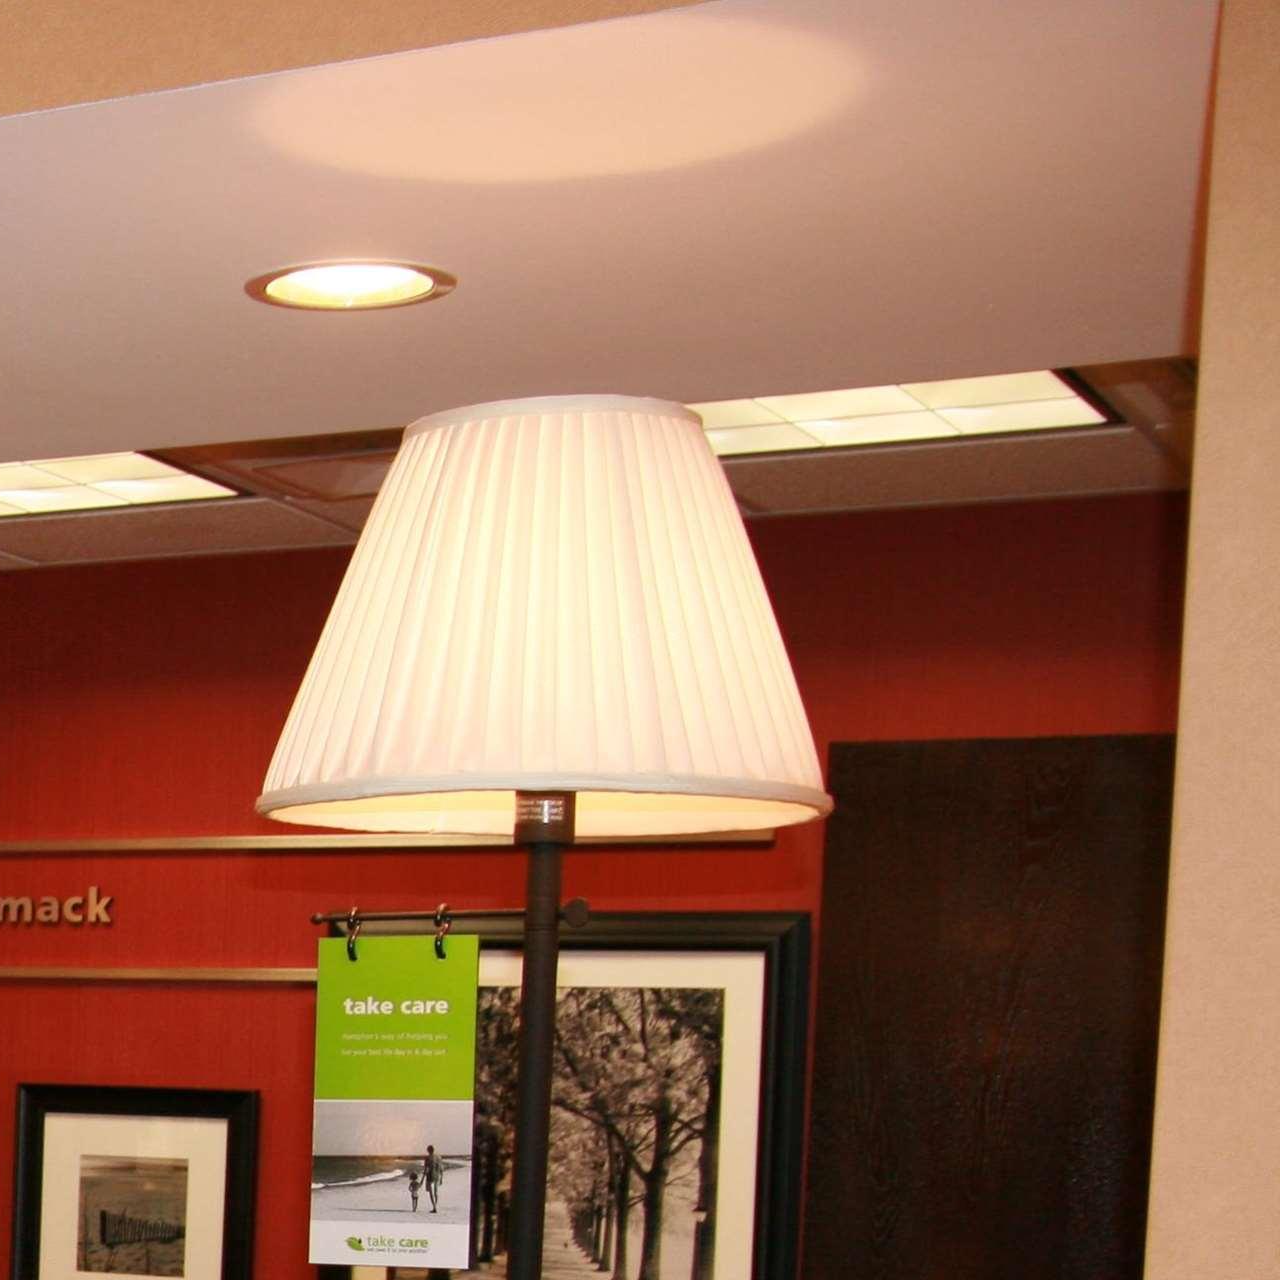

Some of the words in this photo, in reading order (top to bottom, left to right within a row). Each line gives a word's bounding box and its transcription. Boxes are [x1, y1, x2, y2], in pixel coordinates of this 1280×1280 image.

[343, 995, 395, 1015] take
[400, 998, 449, 1015] care
[367, 1235, 395, 1248] take
[399, 1238, 429, 1248] care
